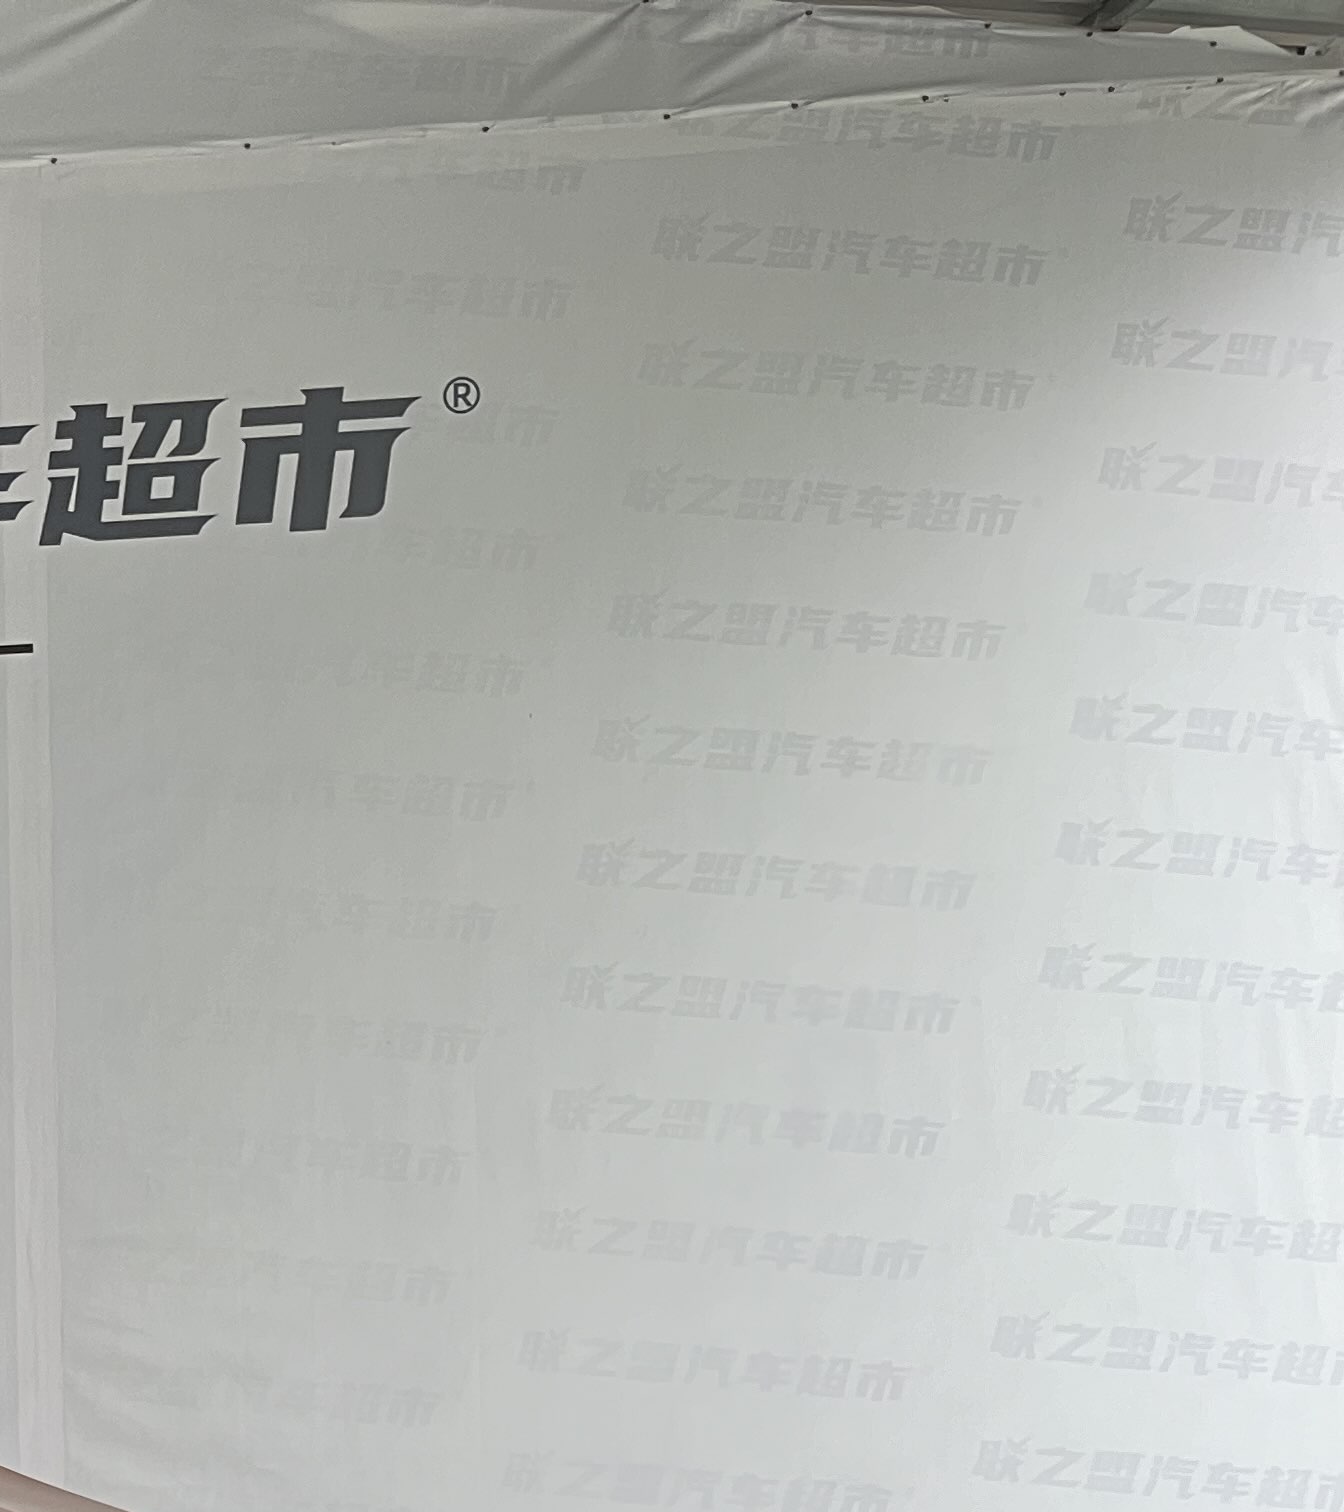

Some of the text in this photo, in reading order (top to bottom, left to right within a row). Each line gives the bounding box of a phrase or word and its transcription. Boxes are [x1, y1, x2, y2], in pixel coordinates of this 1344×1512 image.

[650, 214, 1049, 287] 联之盟汽车超市
[635, 337, 1036, 411] 联之盟汽车超市
[621, 464, 1022, 536] 联之盟汽车超市
[606, 588, 1006, 661] 联之盟汽车超市
[590, 714, 994, 787] 联之盟汽车超市
[575, 838, 977, 911] 联之盟汽车超市
[1055, 818, 1344, 889] 联之盟汽车
[561, 961, 961, 1035] 联之盟汽车超市
[546, 1085, 946, 1158] 联之盟汽车超市
[528, 1208, 928, 1281] 联之盟汽车超市
[516, 1326, 911, 1402] 联之盟汽车超市
